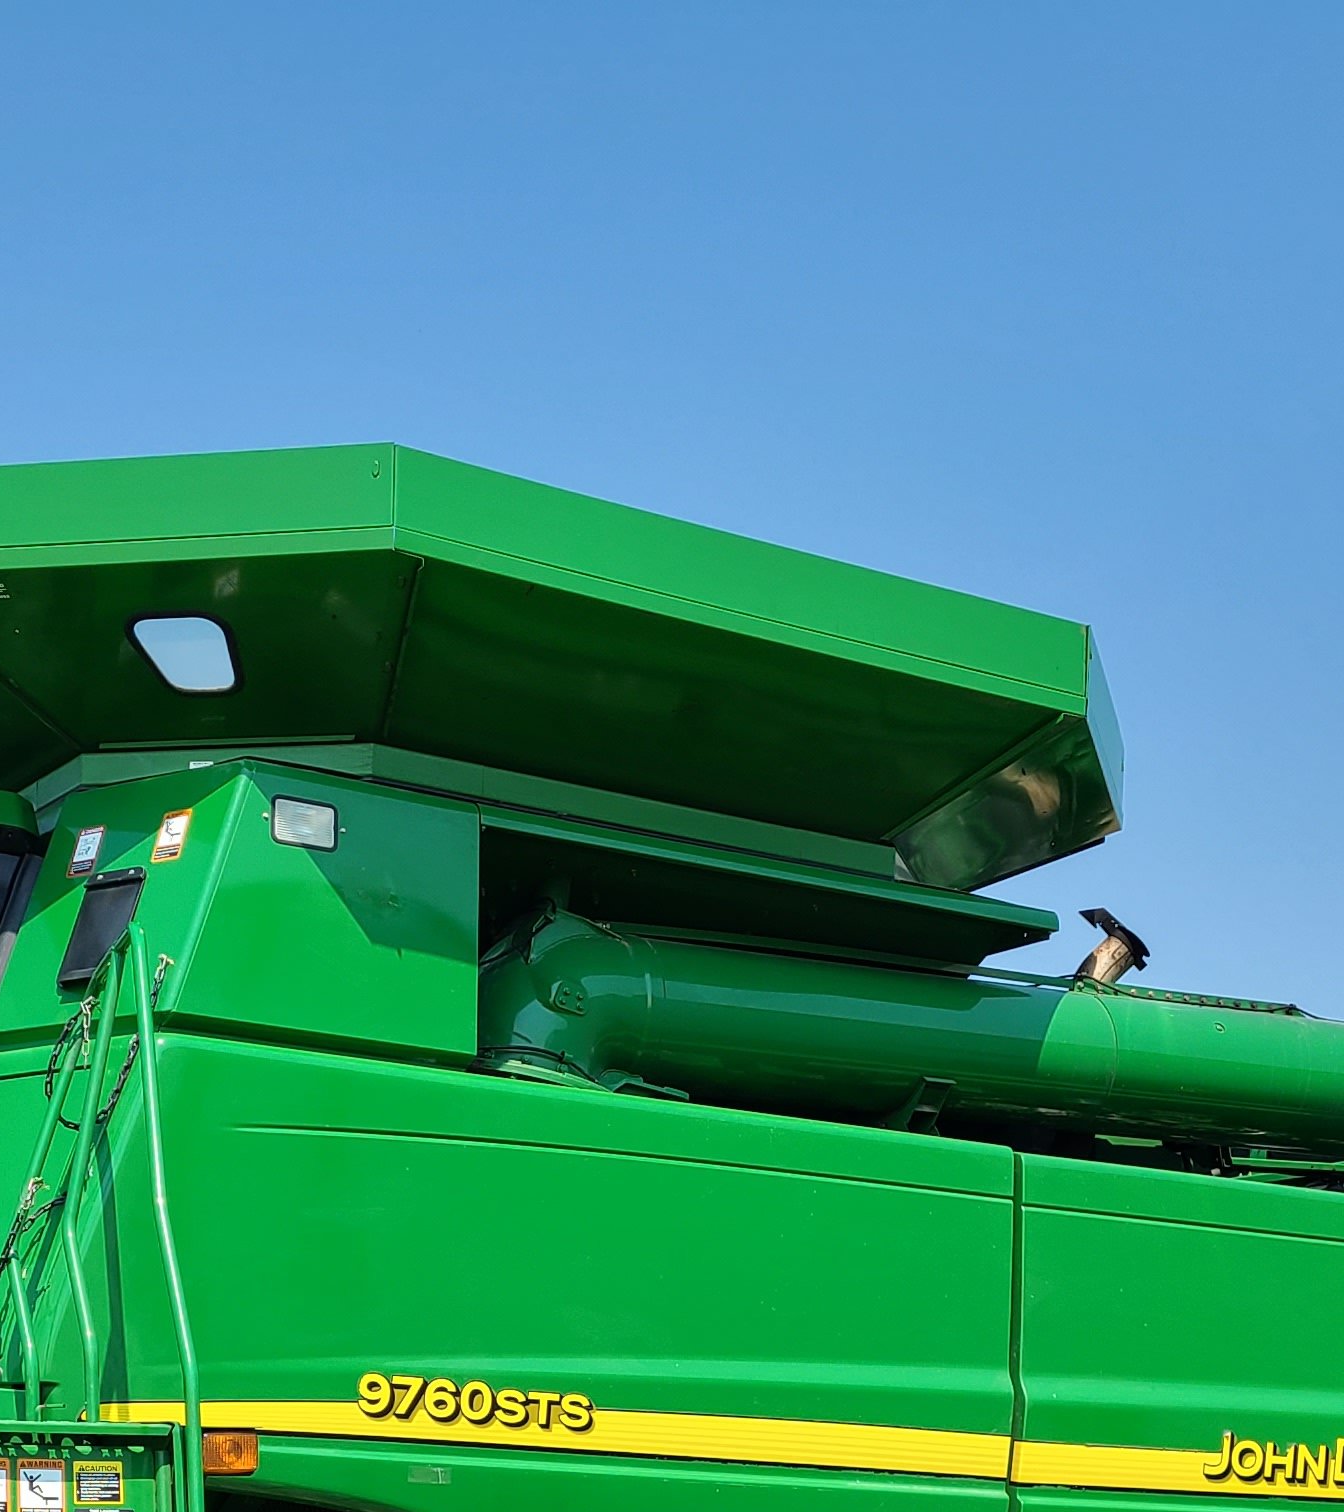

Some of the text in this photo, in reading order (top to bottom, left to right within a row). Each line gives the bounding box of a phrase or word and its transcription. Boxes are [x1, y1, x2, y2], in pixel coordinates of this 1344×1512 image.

[358, 1371, 594, 1432] 9760STS
[26, 1460, 62, 1468] WARNING
[1203, 1430, 1330, 1485] JOHN
